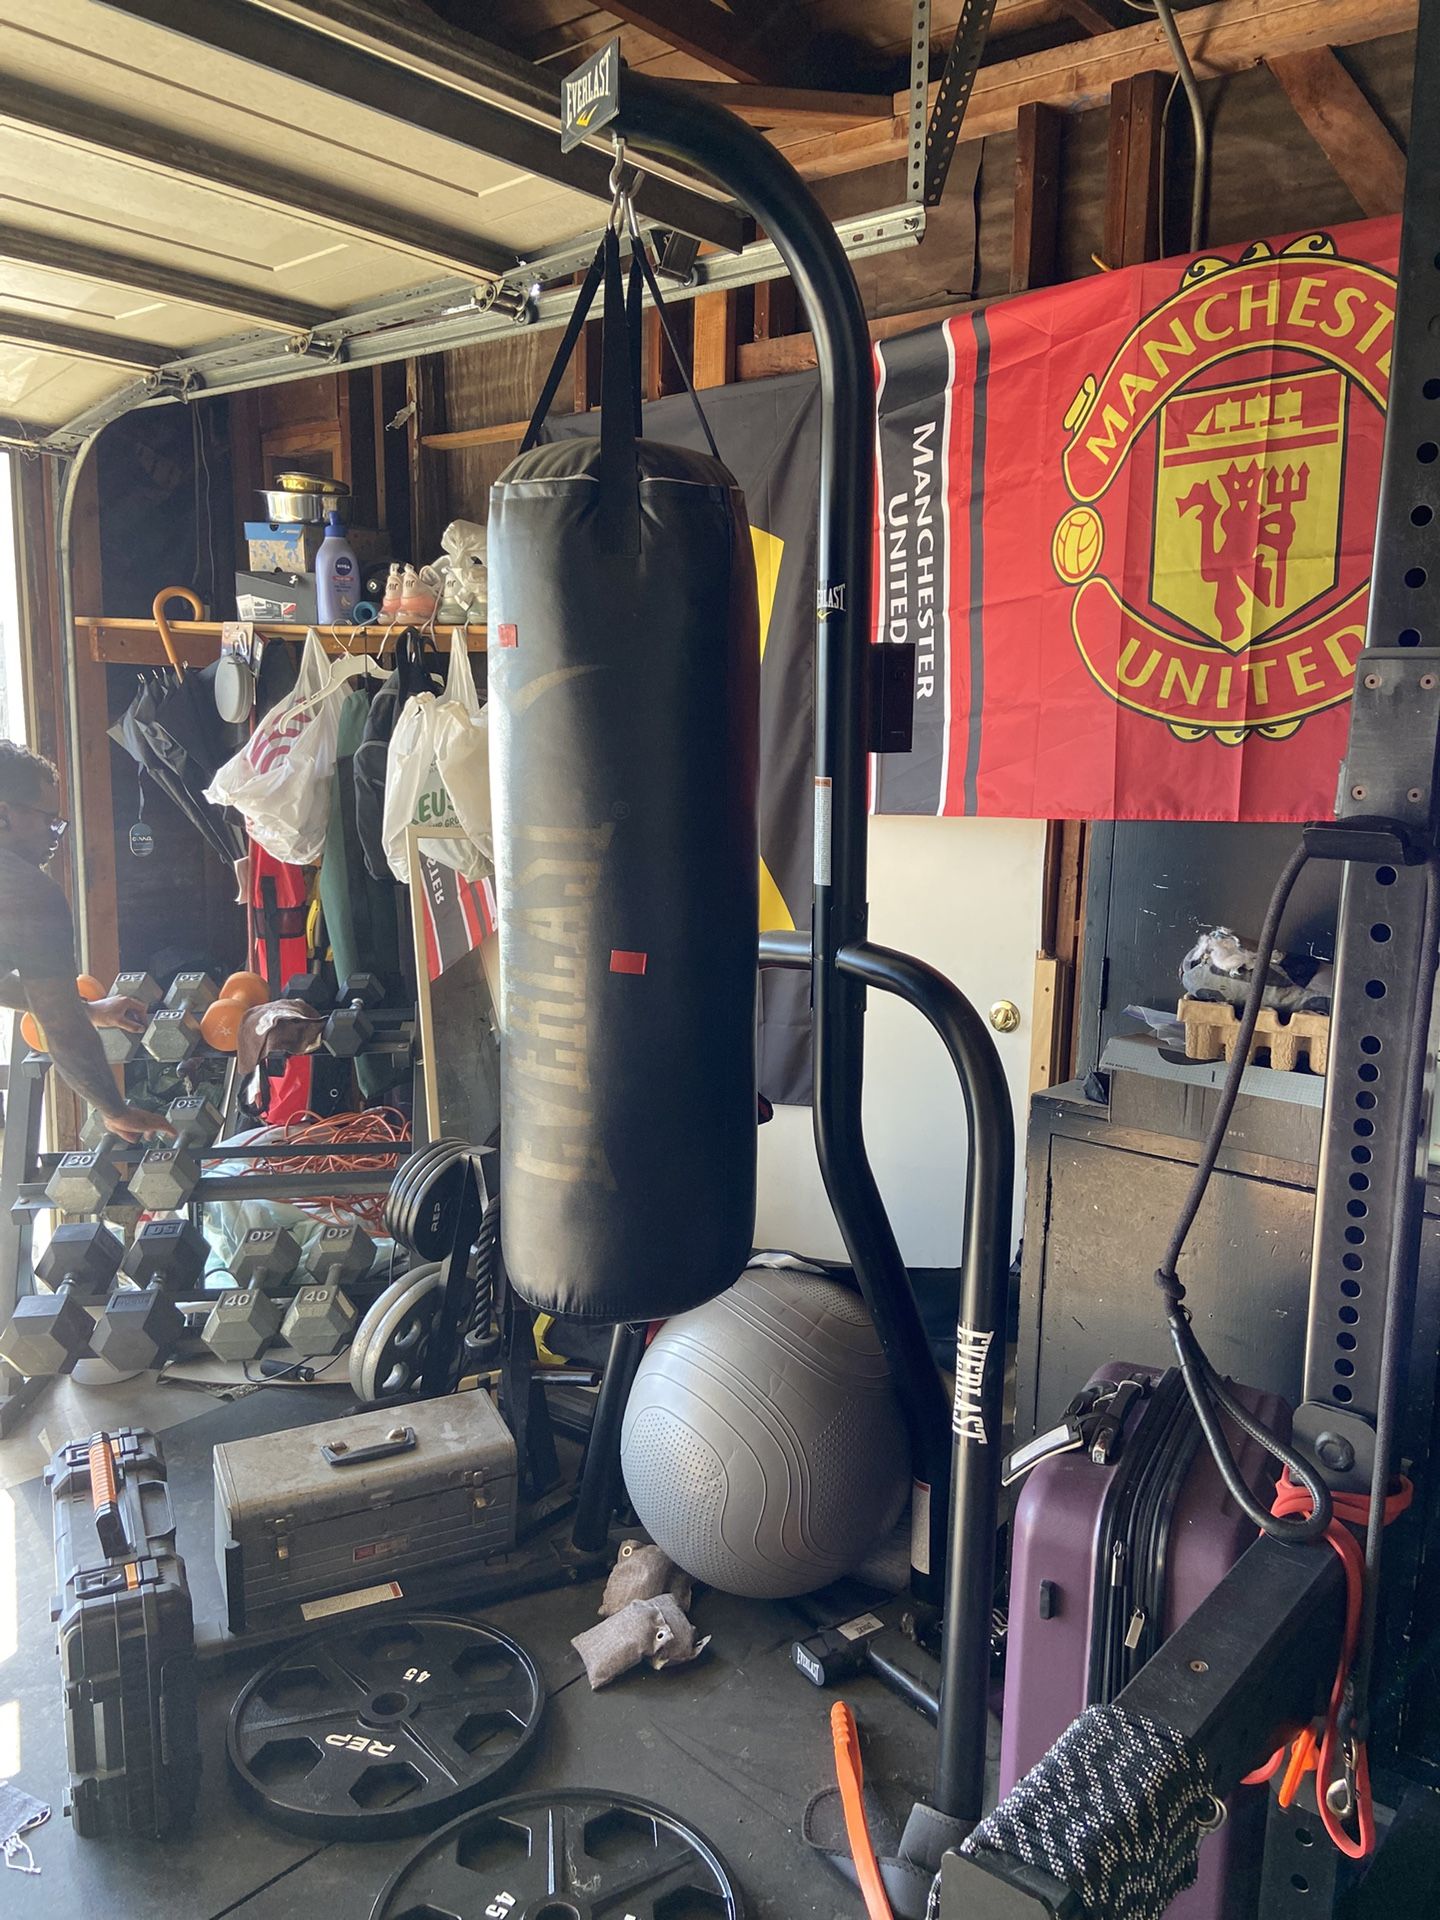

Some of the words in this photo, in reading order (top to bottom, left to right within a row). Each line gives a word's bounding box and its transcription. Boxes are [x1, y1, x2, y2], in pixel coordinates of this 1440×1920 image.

[566, 47, 611, 129] EVERLAST
[1086, 277, 1395, 466] MANCHEST
[888, 492, 908, 643] UNITED
[912, 421, 936, 700] MANCHESTER
[1117, 625, 1366, 708] UNITED
[160, 1011, 181, 1020] 20
[68, 1154, 92, 1166] 30
[431, 1201, 441, 1233] REP
[224, 1293, 250, 1307] 40
[303, 1289, 329, 1302] 40
[952, 1321, 995, 1444] EVERLAST
[402, 1667, 431, 1683] 45
[325, 1733, 396, 1757] REP
[485, 1891, 517, 1920] 45
